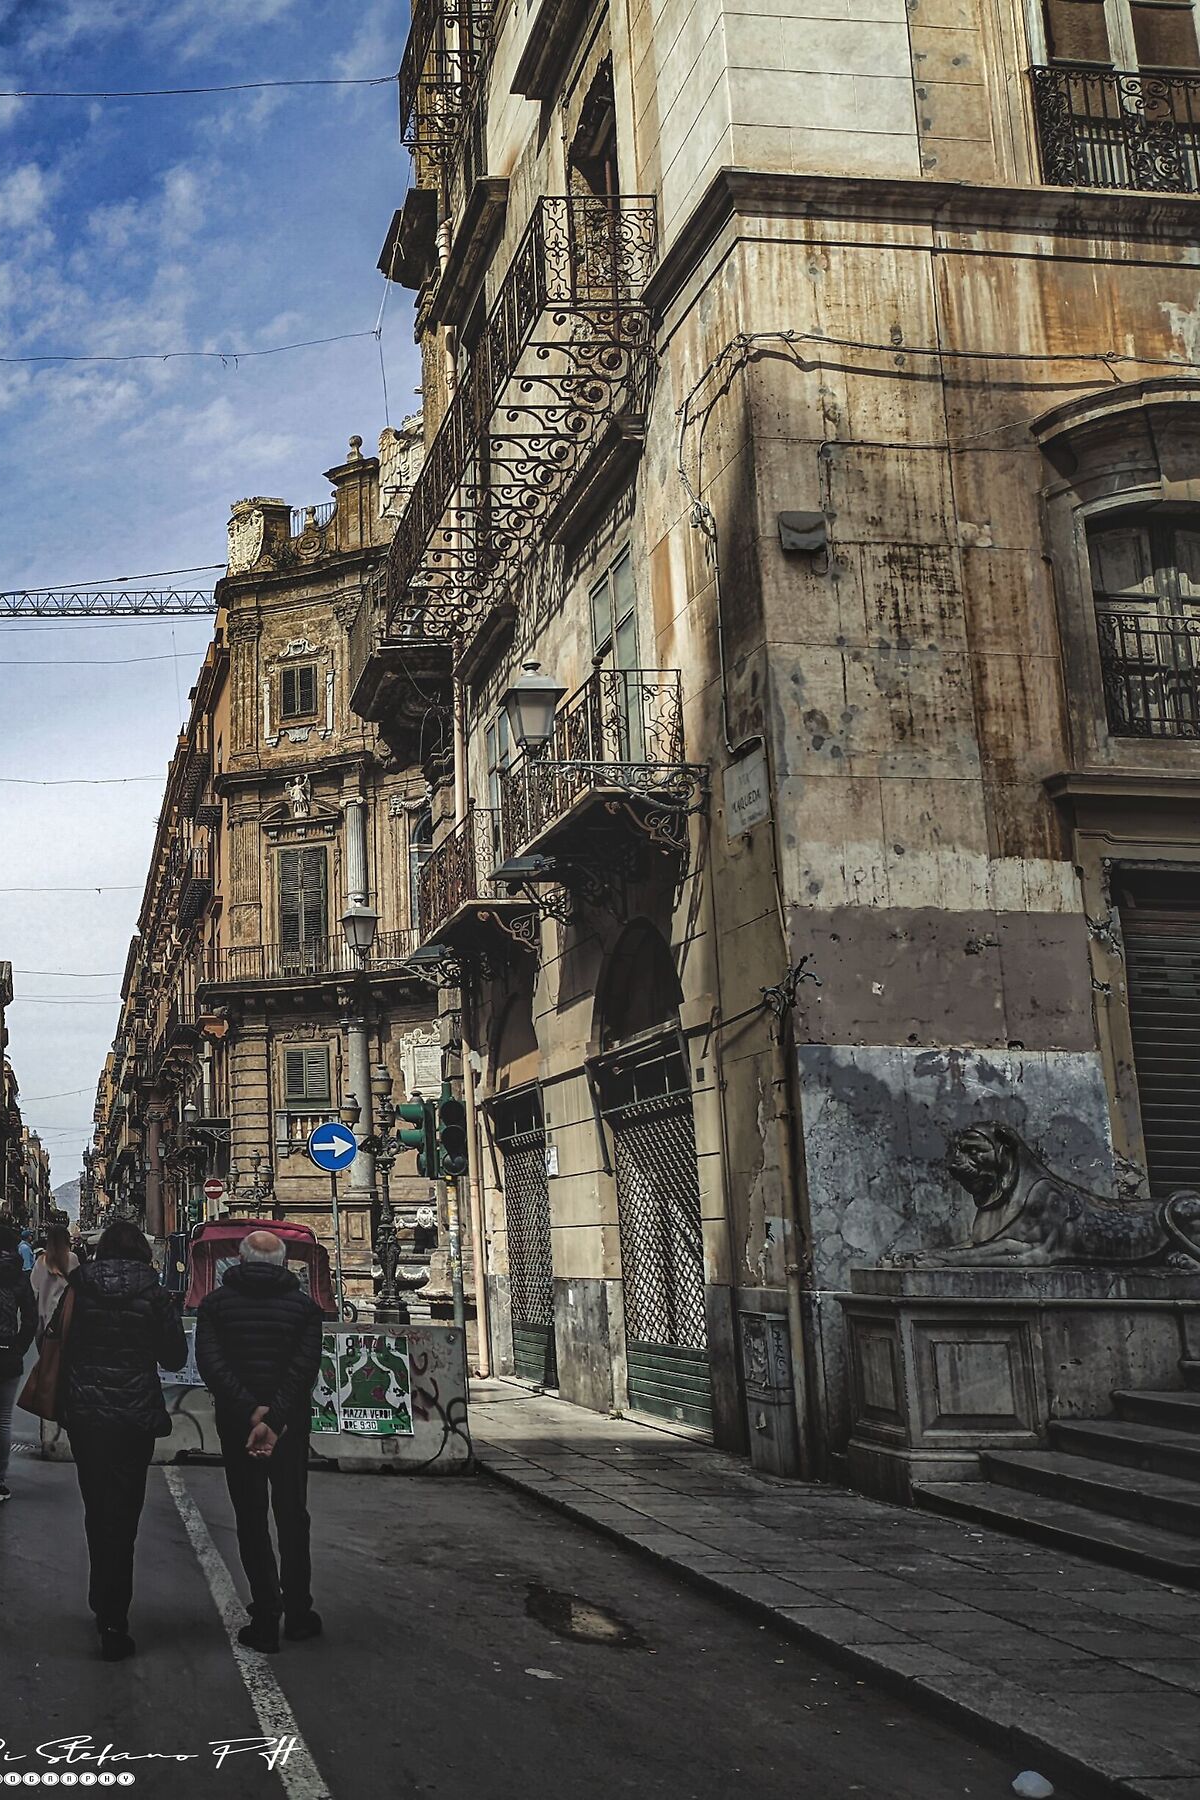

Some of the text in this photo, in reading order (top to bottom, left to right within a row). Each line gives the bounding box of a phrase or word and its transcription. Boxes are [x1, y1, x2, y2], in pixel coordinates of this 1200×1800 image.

[342, 1409, 391, 1419] PIAZZA VERDI
[343, 1421, 358, 1430] ORE
